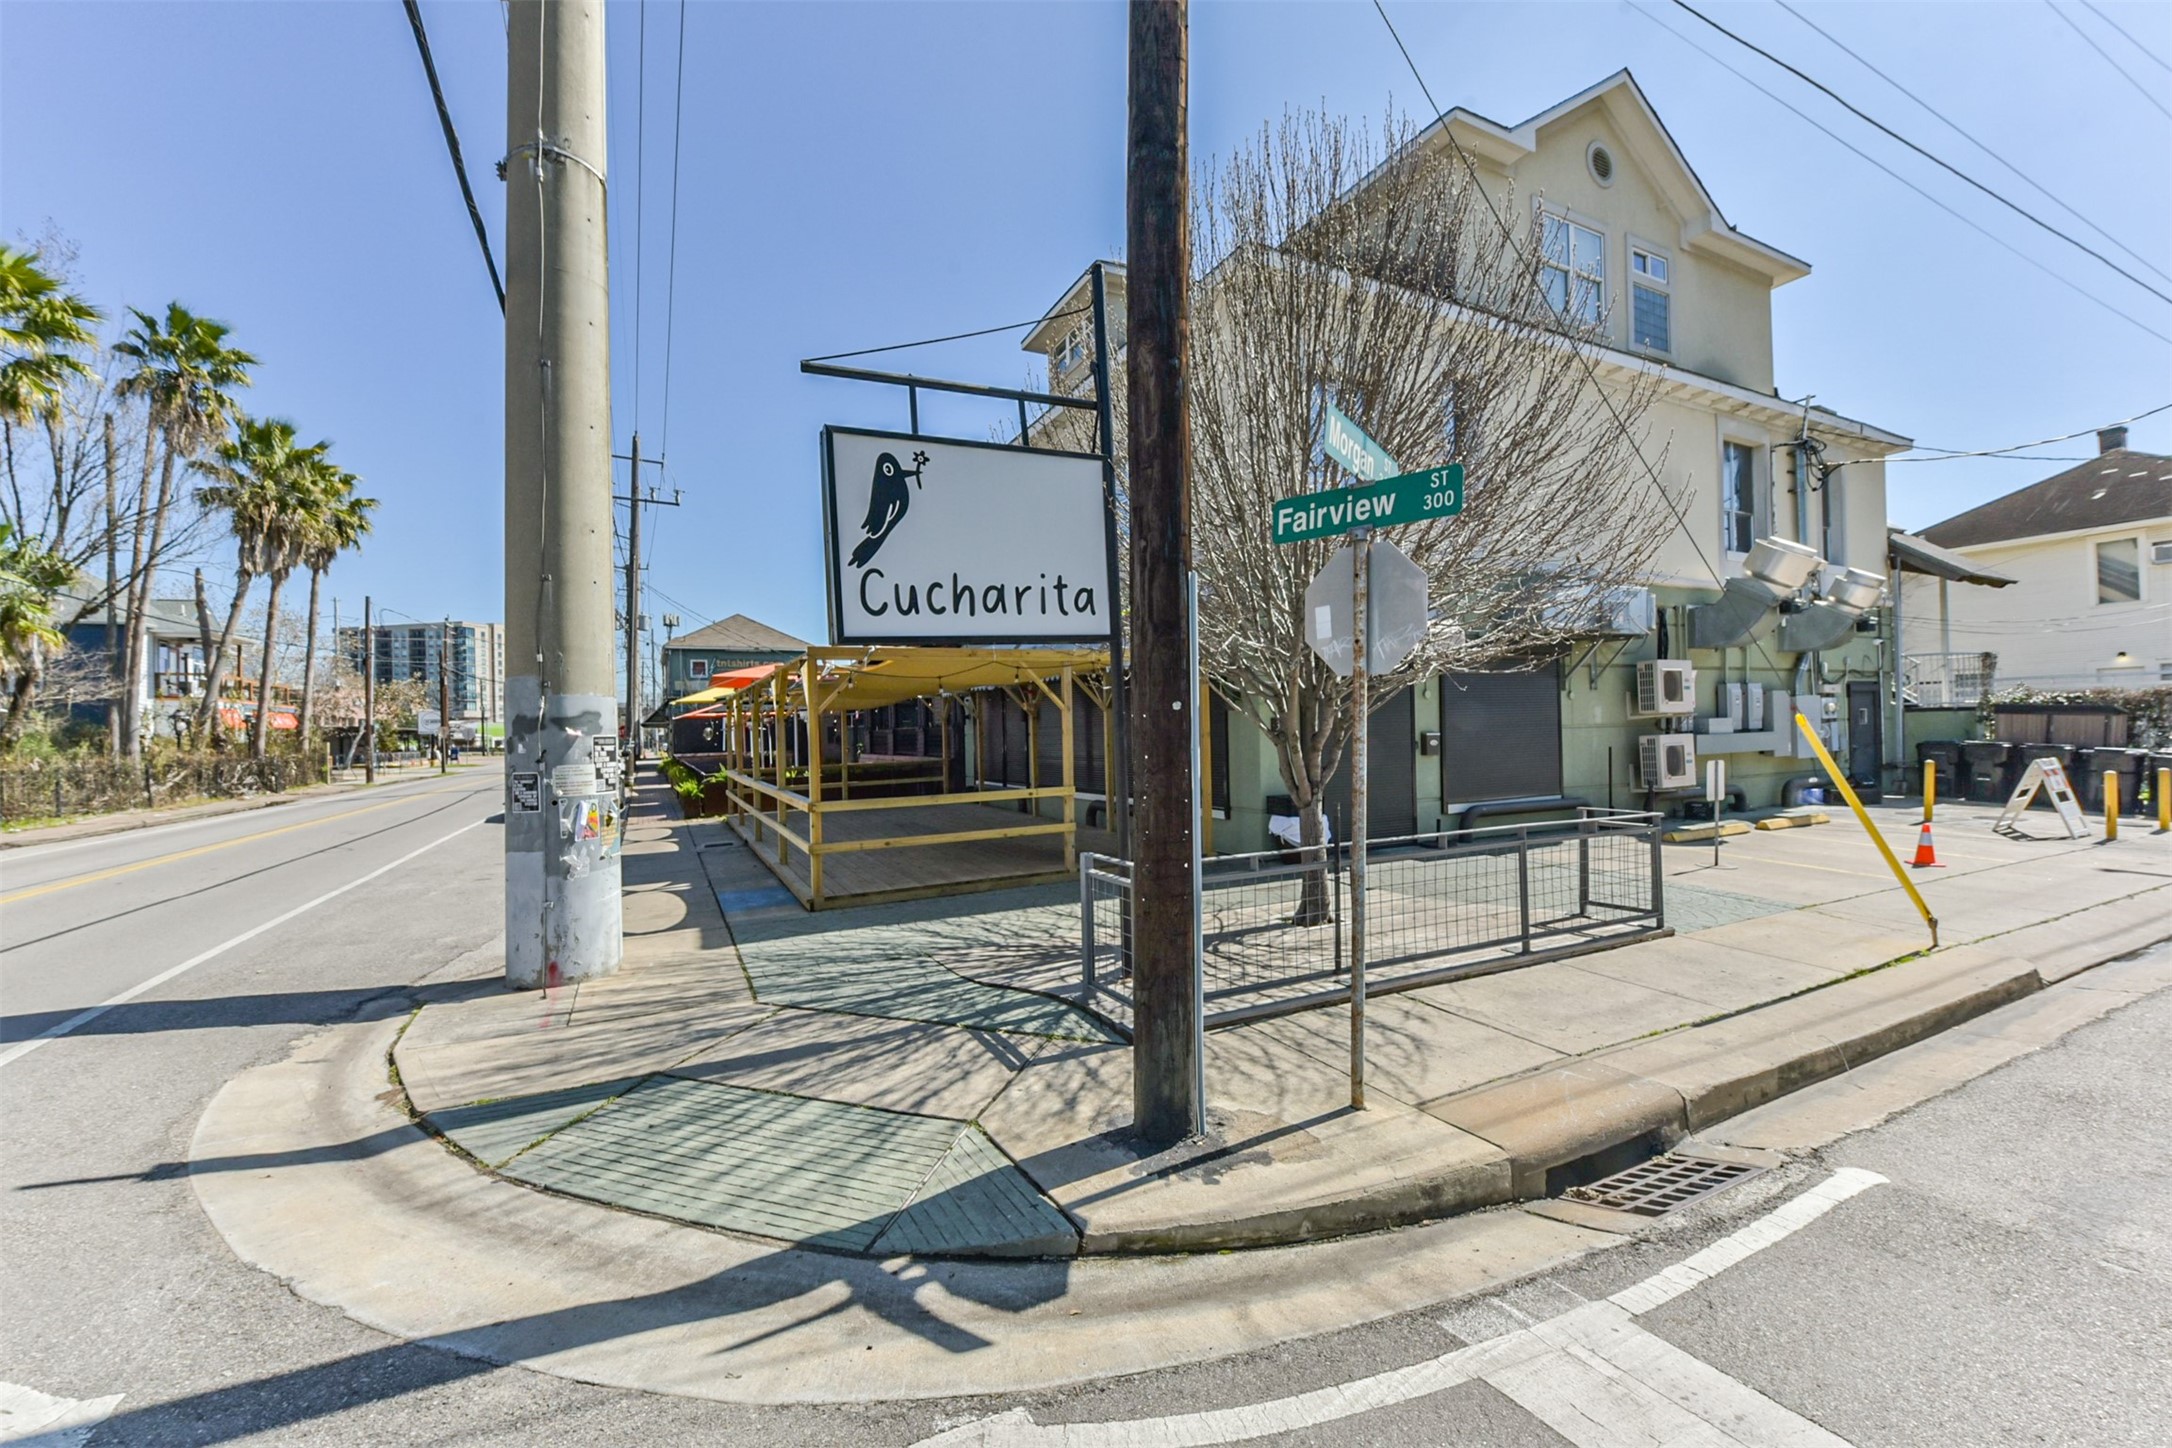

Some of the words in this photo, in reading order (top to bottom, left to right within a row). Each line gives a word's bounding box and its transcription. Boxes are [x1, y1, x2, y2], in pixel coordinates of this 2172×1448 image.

[1329, 415, 1375, 478] Morgan
[1383, 457, 1393, 475] ST
[1277, 493, 1397, 535] Fairview
[1430, 470, 1449, 488] ST
[1423, 490, 1455, 510] 300
[860, 568, 1096, 616] Cucharita
